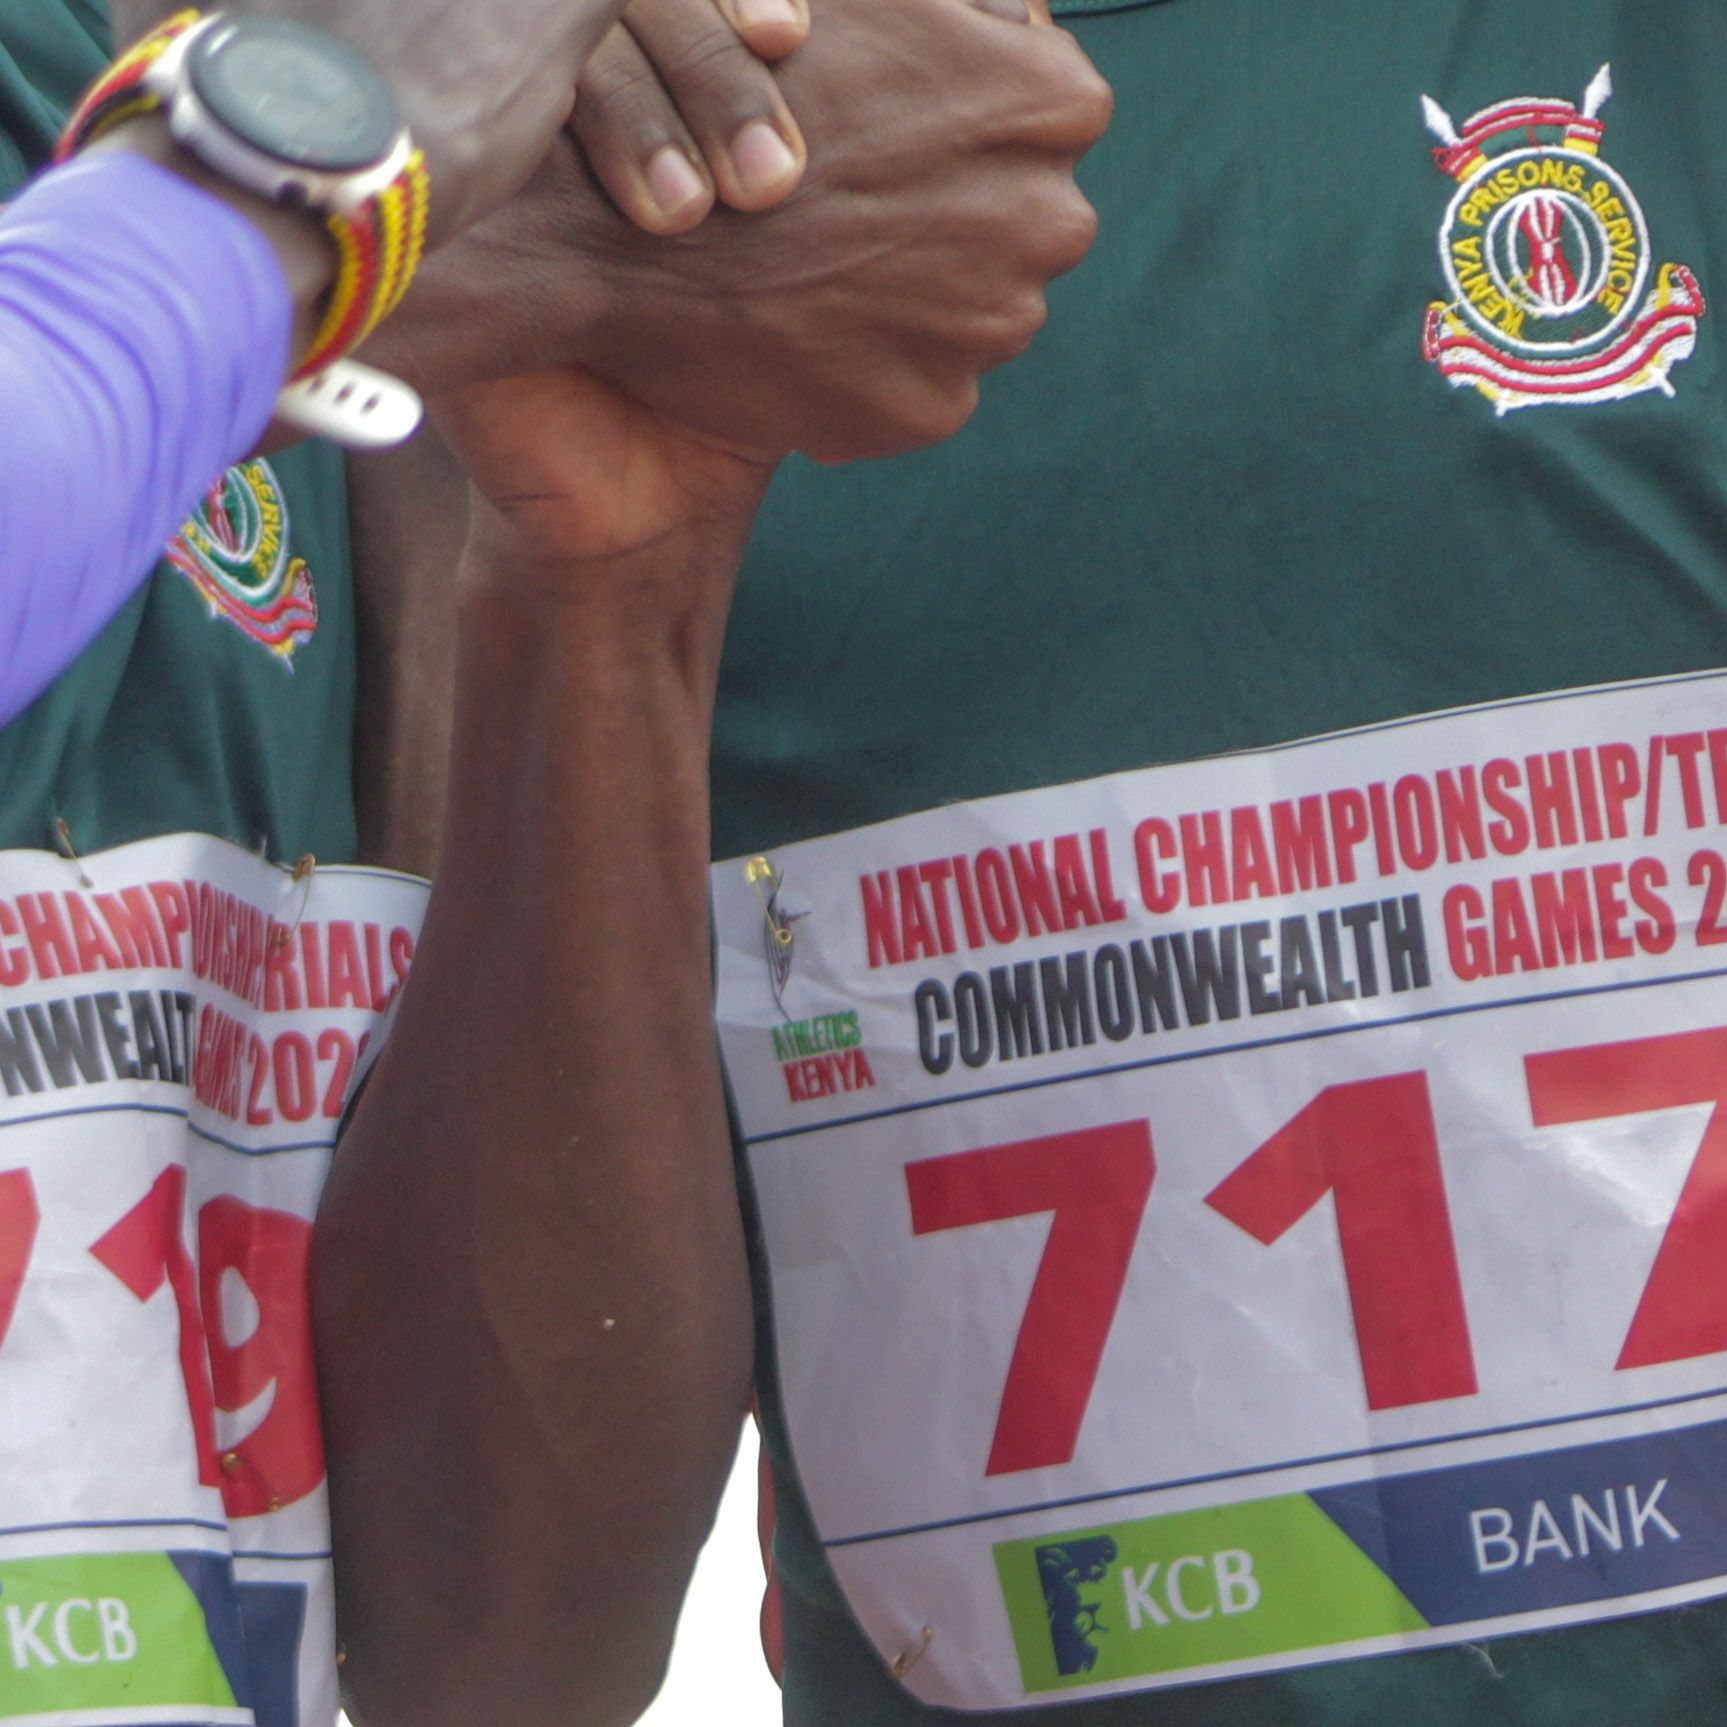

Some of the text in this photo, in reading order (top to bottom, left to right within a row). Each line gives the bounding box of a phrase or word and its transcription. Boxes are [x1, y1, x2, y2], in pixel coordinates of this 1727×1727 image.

[1453, 158, 1637, 340] KENYA PRISONS SERVICE
[860, 827, 1127, 969] NATIONAL
[914, 892, 1431, 1075] COMMONWEALTH
[1442, 856, 1677, 983] GAMES
[245, 1027, 371, 1126] 202
[783, 1046, 876, 1103] KENYA
[1121, 1478, 1681, 1631] KCB BANK
[5, 1597, 137, 1669] KCB
